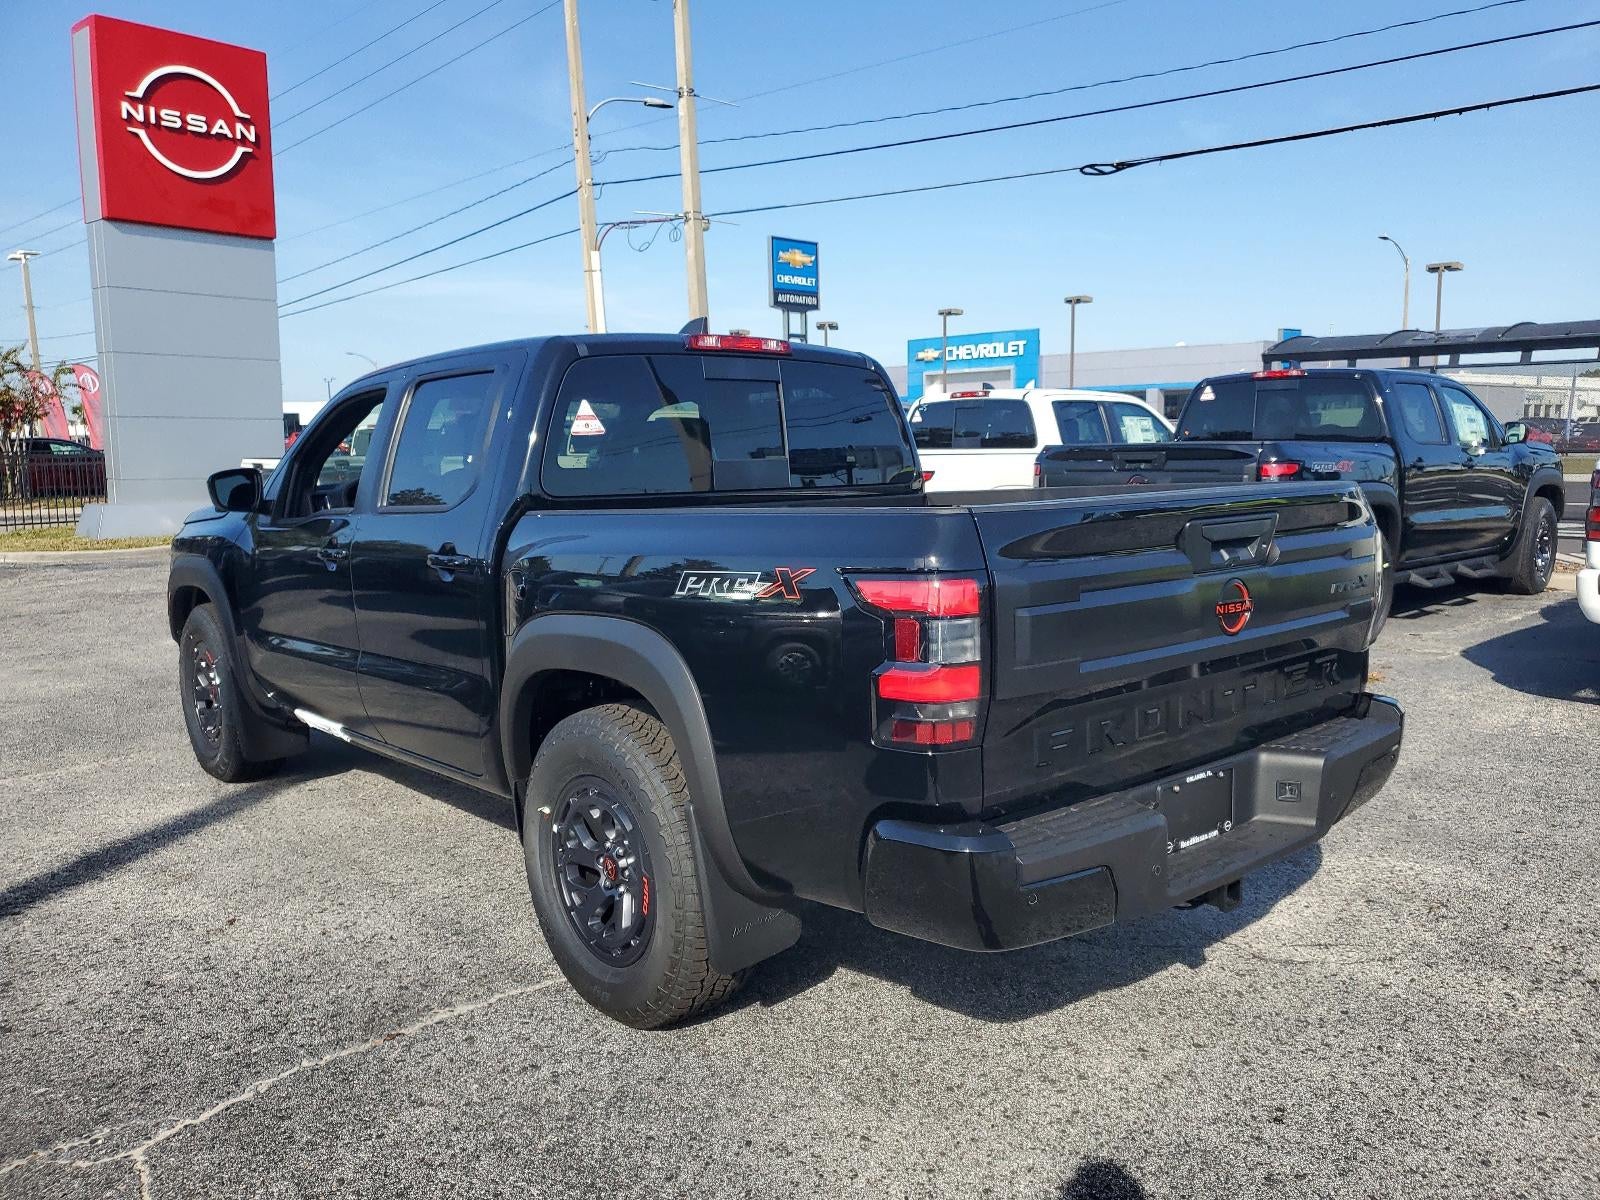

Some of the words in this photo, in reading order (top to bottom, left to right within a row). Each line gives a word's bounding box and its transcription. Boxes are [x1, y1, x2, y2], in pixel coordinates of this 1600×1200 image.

[120, 101, 256, 142] NISSAN
[776, 274, 816, 286] CHEVROLET
[777, 294, 817, 306] AUTONATION
[945, 340, 1027, 361] CHEVROLET
[1216, 601, 1252, 615] NISSAN
[1034, 653, 1341, 767] FRONTIER
